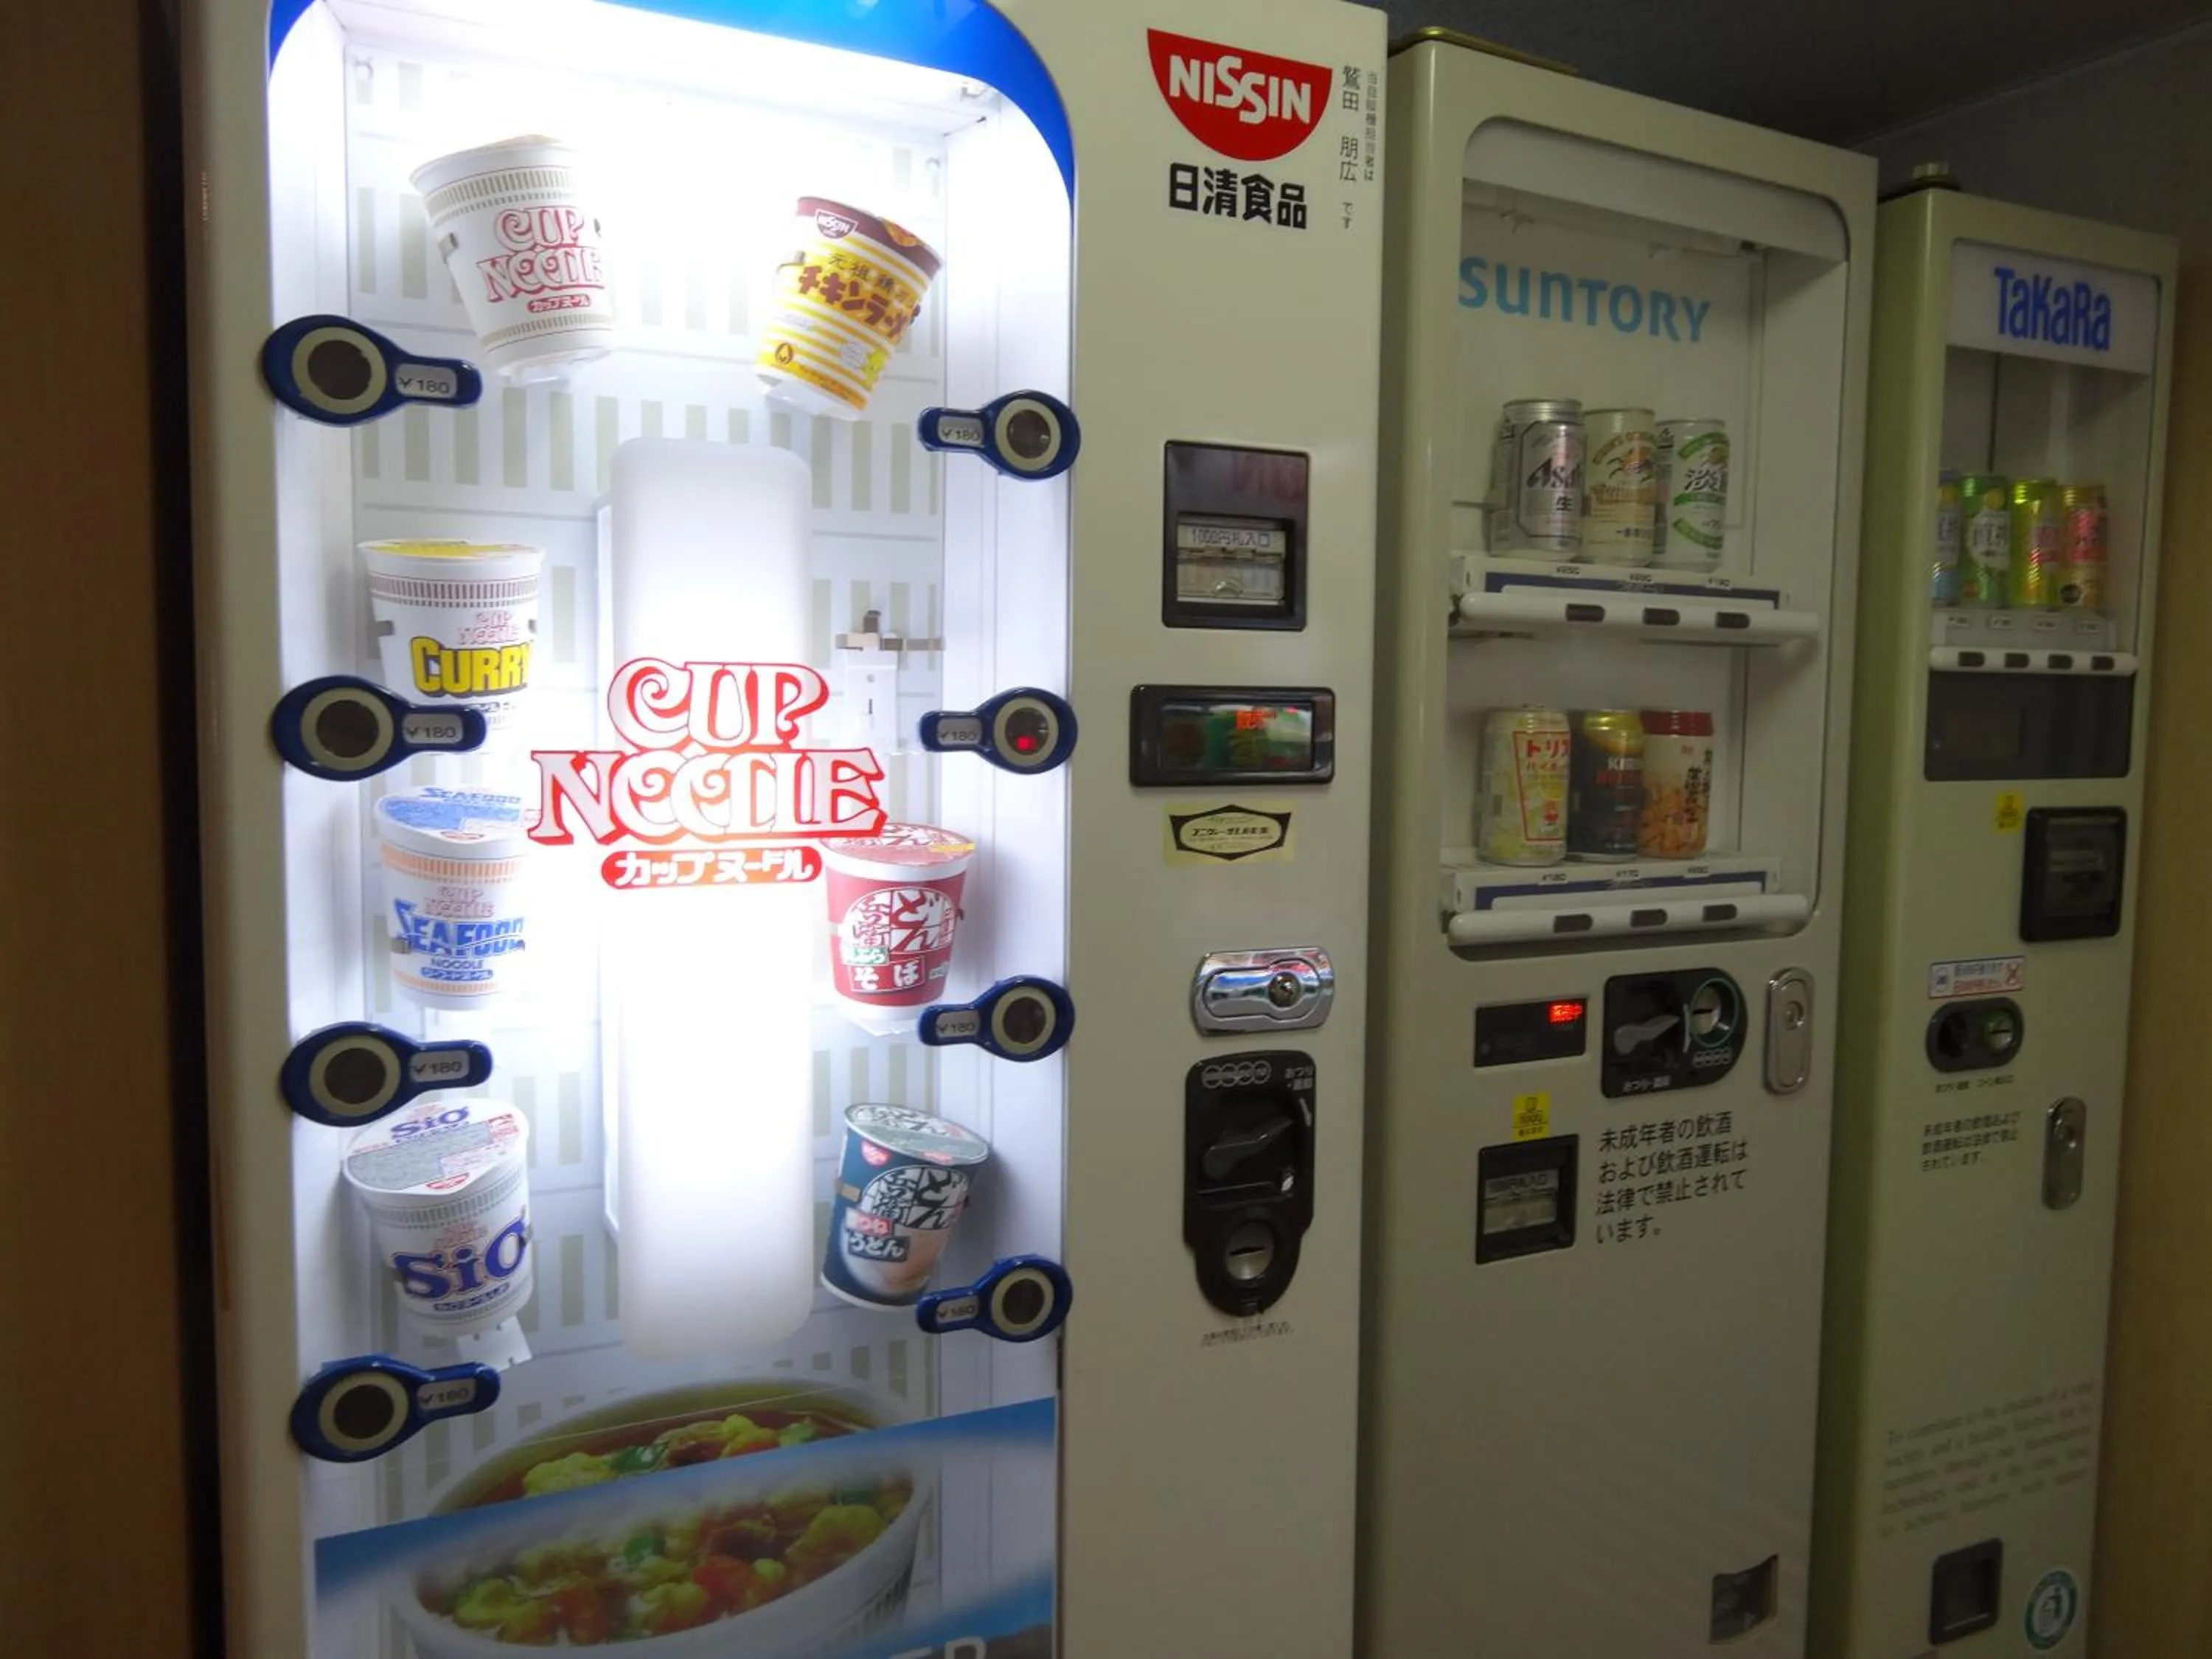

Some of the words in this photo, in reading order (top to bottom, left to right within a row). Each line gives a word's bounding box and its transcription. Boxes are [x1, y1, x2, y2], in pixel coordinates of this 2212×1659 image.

[1169, 55, 1311, 125] NISSIN
[1169, 161, 1307, 229] 日清食品
[493, 205, 585, 252] CUP
[398, 375, 451, 394] ¥180
[410, 636, 532, 698] CURRY
[607, 656, 830, 754] CUP
[405, 723, 459, 740] ¥180
[526, 747, 888, 846] NOODLE
[613, 848, 814, 886] カップヌードル
[394, 897, 525, 959] SEAFOOD
[853, 959, 922, 991] そば
[1599, 1110, 1733, 1153] 未成年者の飲酒
[1597, 1141, 1749, 1186] および飲酒運転は
[1595, 1169, 1748, 1217] 法律で禁止されて
[849, 1232, 905, 1257] うどん
[1595, 1215, 1663, 1245] います。
